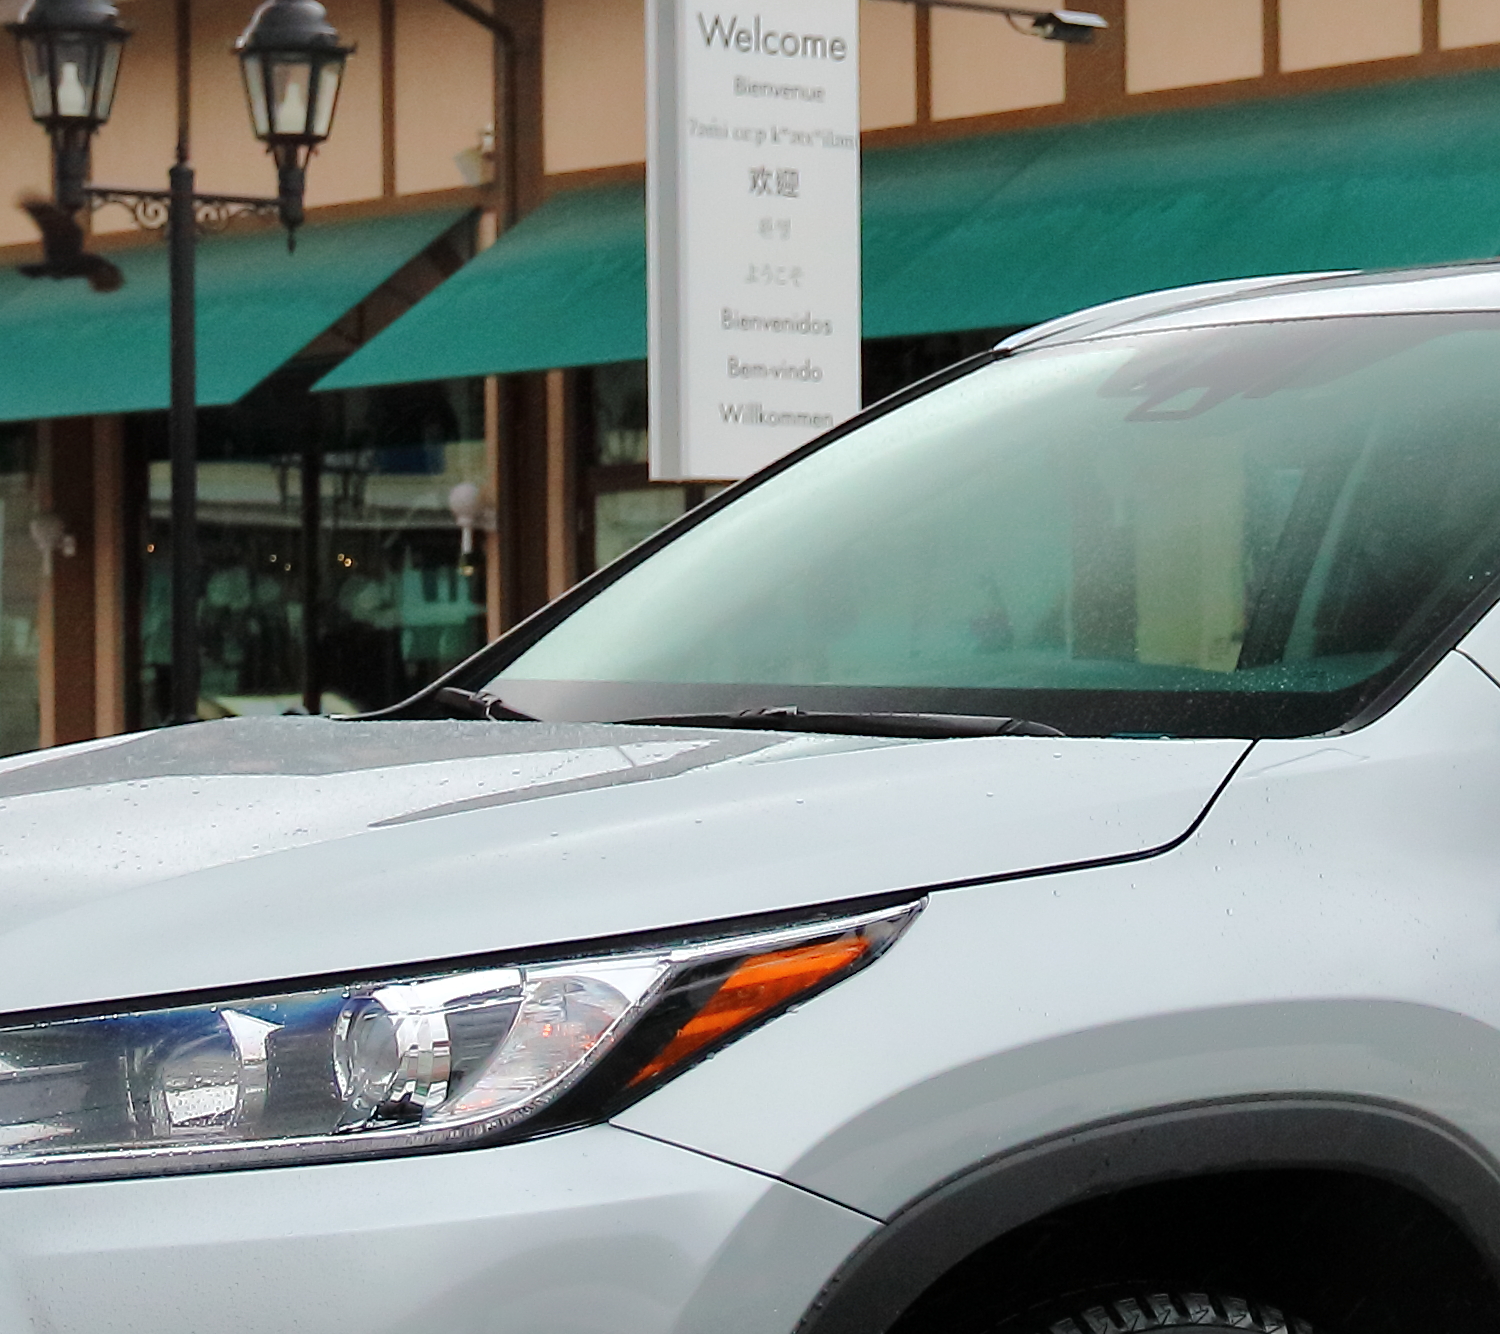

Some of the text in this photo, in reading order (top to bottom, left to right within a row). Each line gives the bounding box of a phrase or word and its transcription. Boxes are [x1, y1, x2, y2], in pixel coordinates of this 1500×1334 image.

[696, 11, 848, 62] Welcome
[733, 74, 826, 103] Bienvenue
[749, 165, 800, 199] 欢迎
[720, 306, 833, 336] Bienvenidos
[727, 355, 823, 383] Bem-vindo
[719, 403, 836, 432] Willkommen
